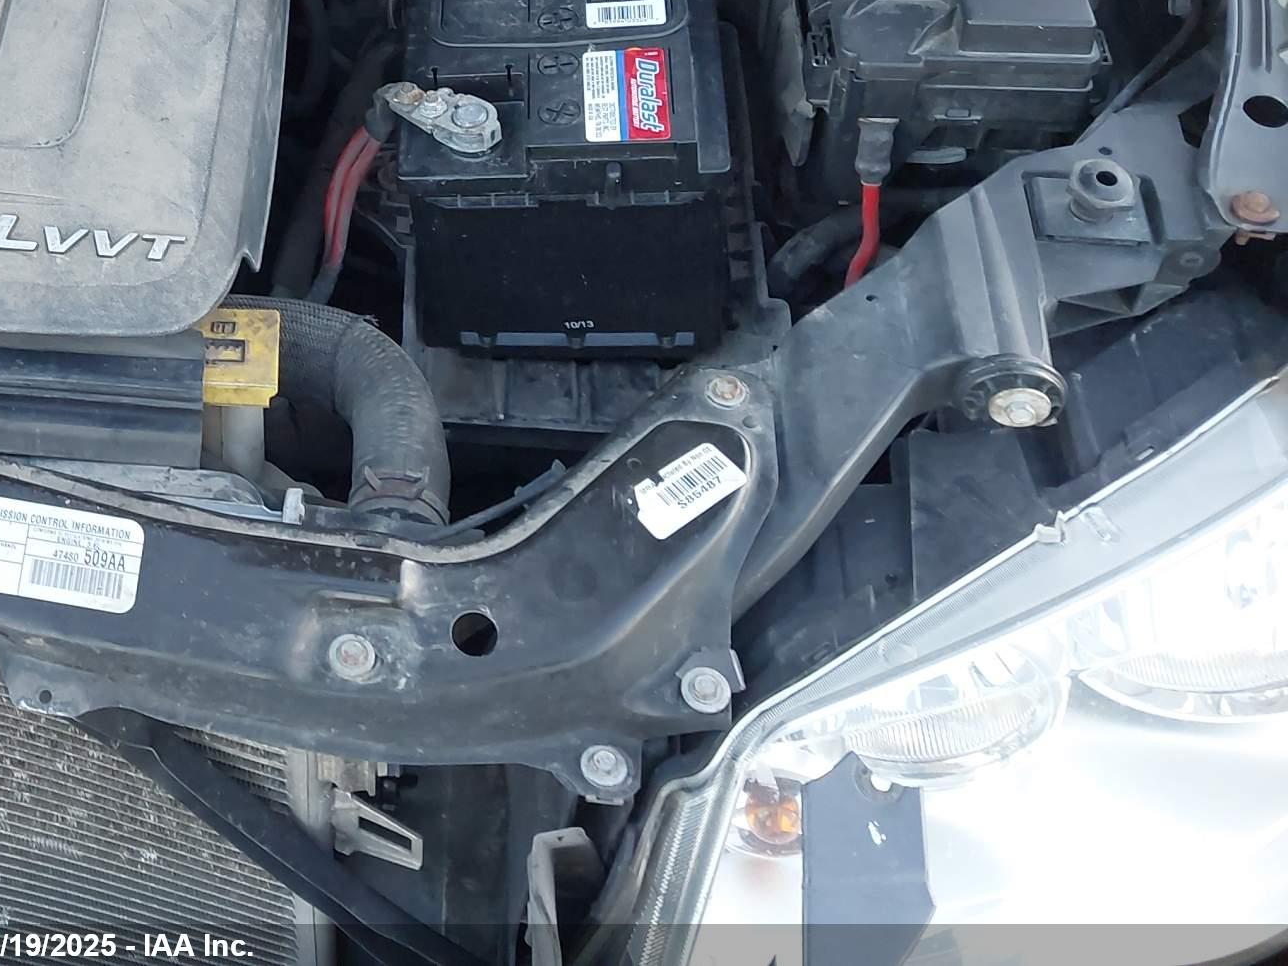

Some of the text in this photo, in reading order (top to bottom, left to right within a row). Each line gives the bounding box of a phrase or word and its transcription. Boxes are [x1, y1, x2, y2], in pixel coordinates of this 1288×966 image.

[635, 58, 665, 133] Duralast
[42, 224, 188, 262] VVT
[563, 319, 595, 330] 10/13
[30, 513, 69, 529] CONTROL
[72, 519, 131, 540] INFORMATION
[84, 548, 126, 572] 509AA
